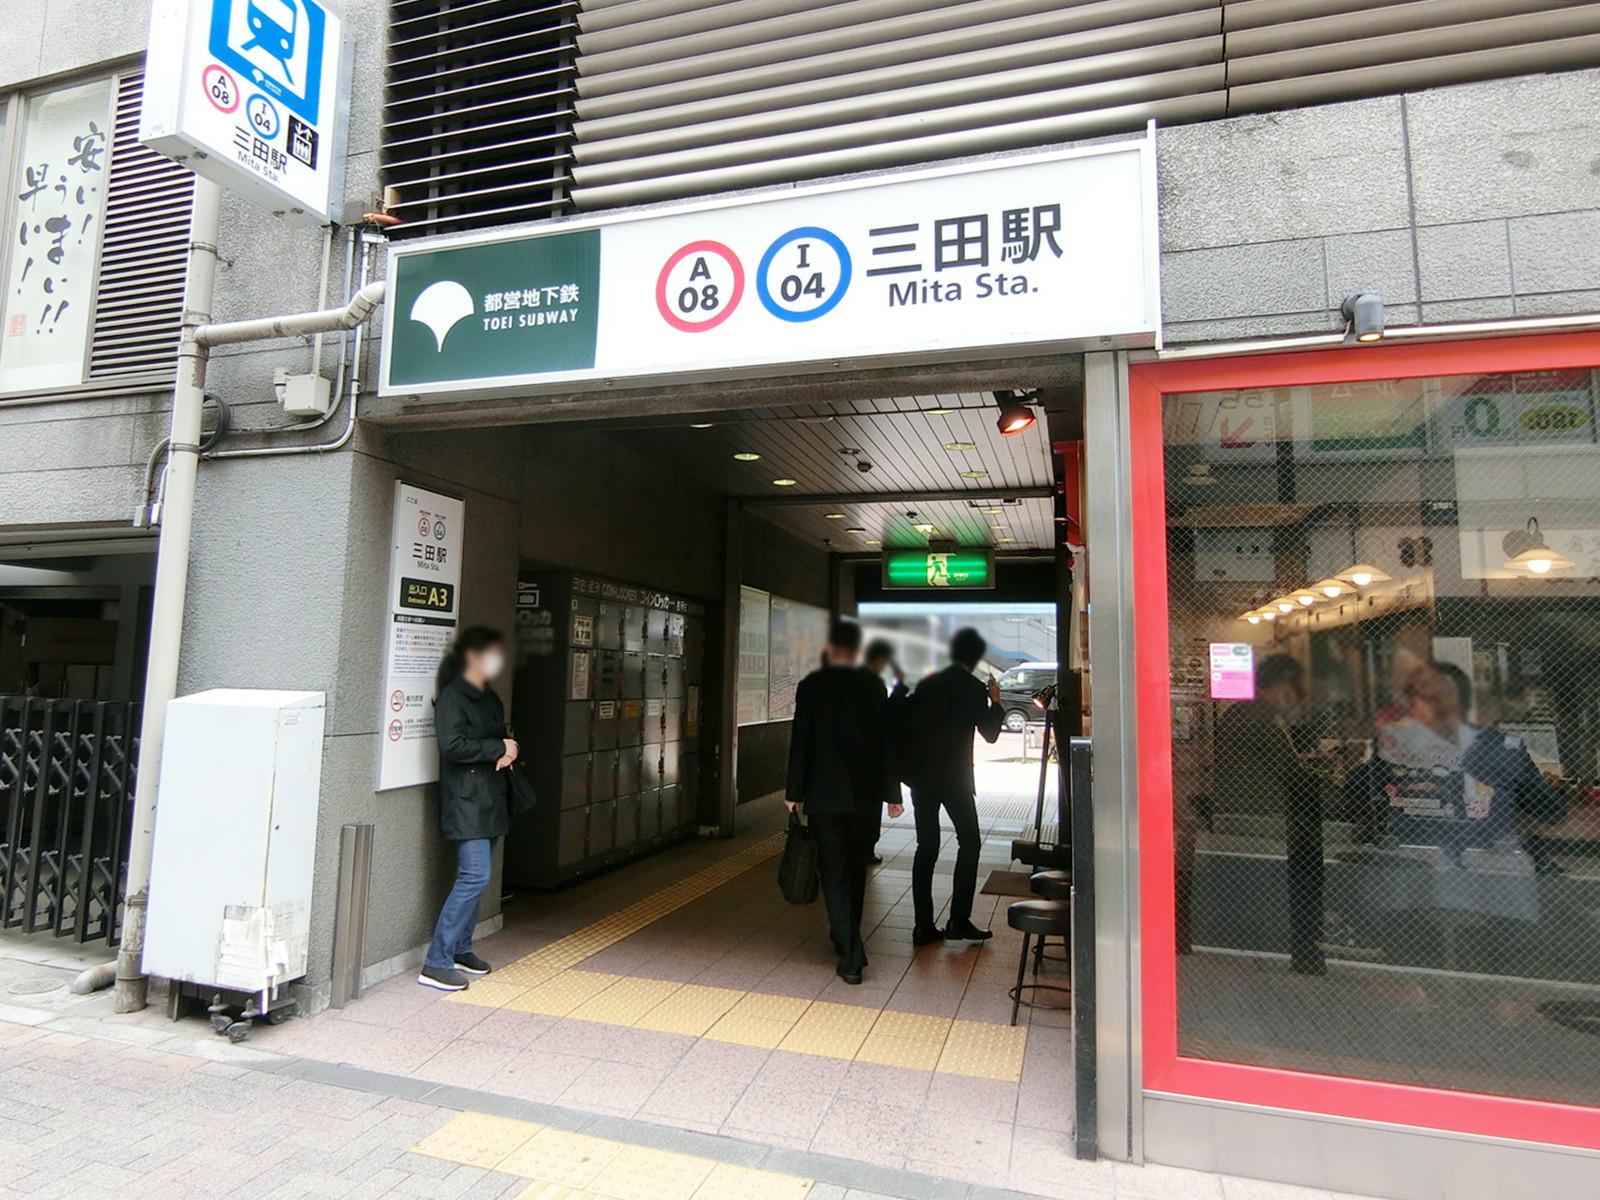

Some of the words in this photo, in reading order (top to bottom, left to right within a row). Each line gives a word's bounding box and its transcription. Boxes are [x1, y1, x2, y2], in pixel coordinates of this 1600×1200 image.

[212, 85, 229, 104] 08
[218, 75, 226, 89] A
[261, 102, 267, 115] I
[255, 113, 271, 131] 04
[233, 125, 288, 175] 三田駅
[238, 151, 260, 171] Mita
[263, 166, 281, 184] Sta.
[866, 203, 1064, 277] 三田駅
[797, 243, 811, 268] I
[689, 256, 712, 282] A
[484, 283, 580, 313] 都営地下鉄
[678, 284, 719, 314] 08
[780, 272, 826, 302] 04
[888, 279, 963, 308] Mita
[975, 272, 1039, 299] Sta.
[483, 313, 513, 332] TOEI
[519, 308, 579, 329] SUBWAY
[412, 542, 447, 564] 三田駅
[427, 587, 448, 607] A3
